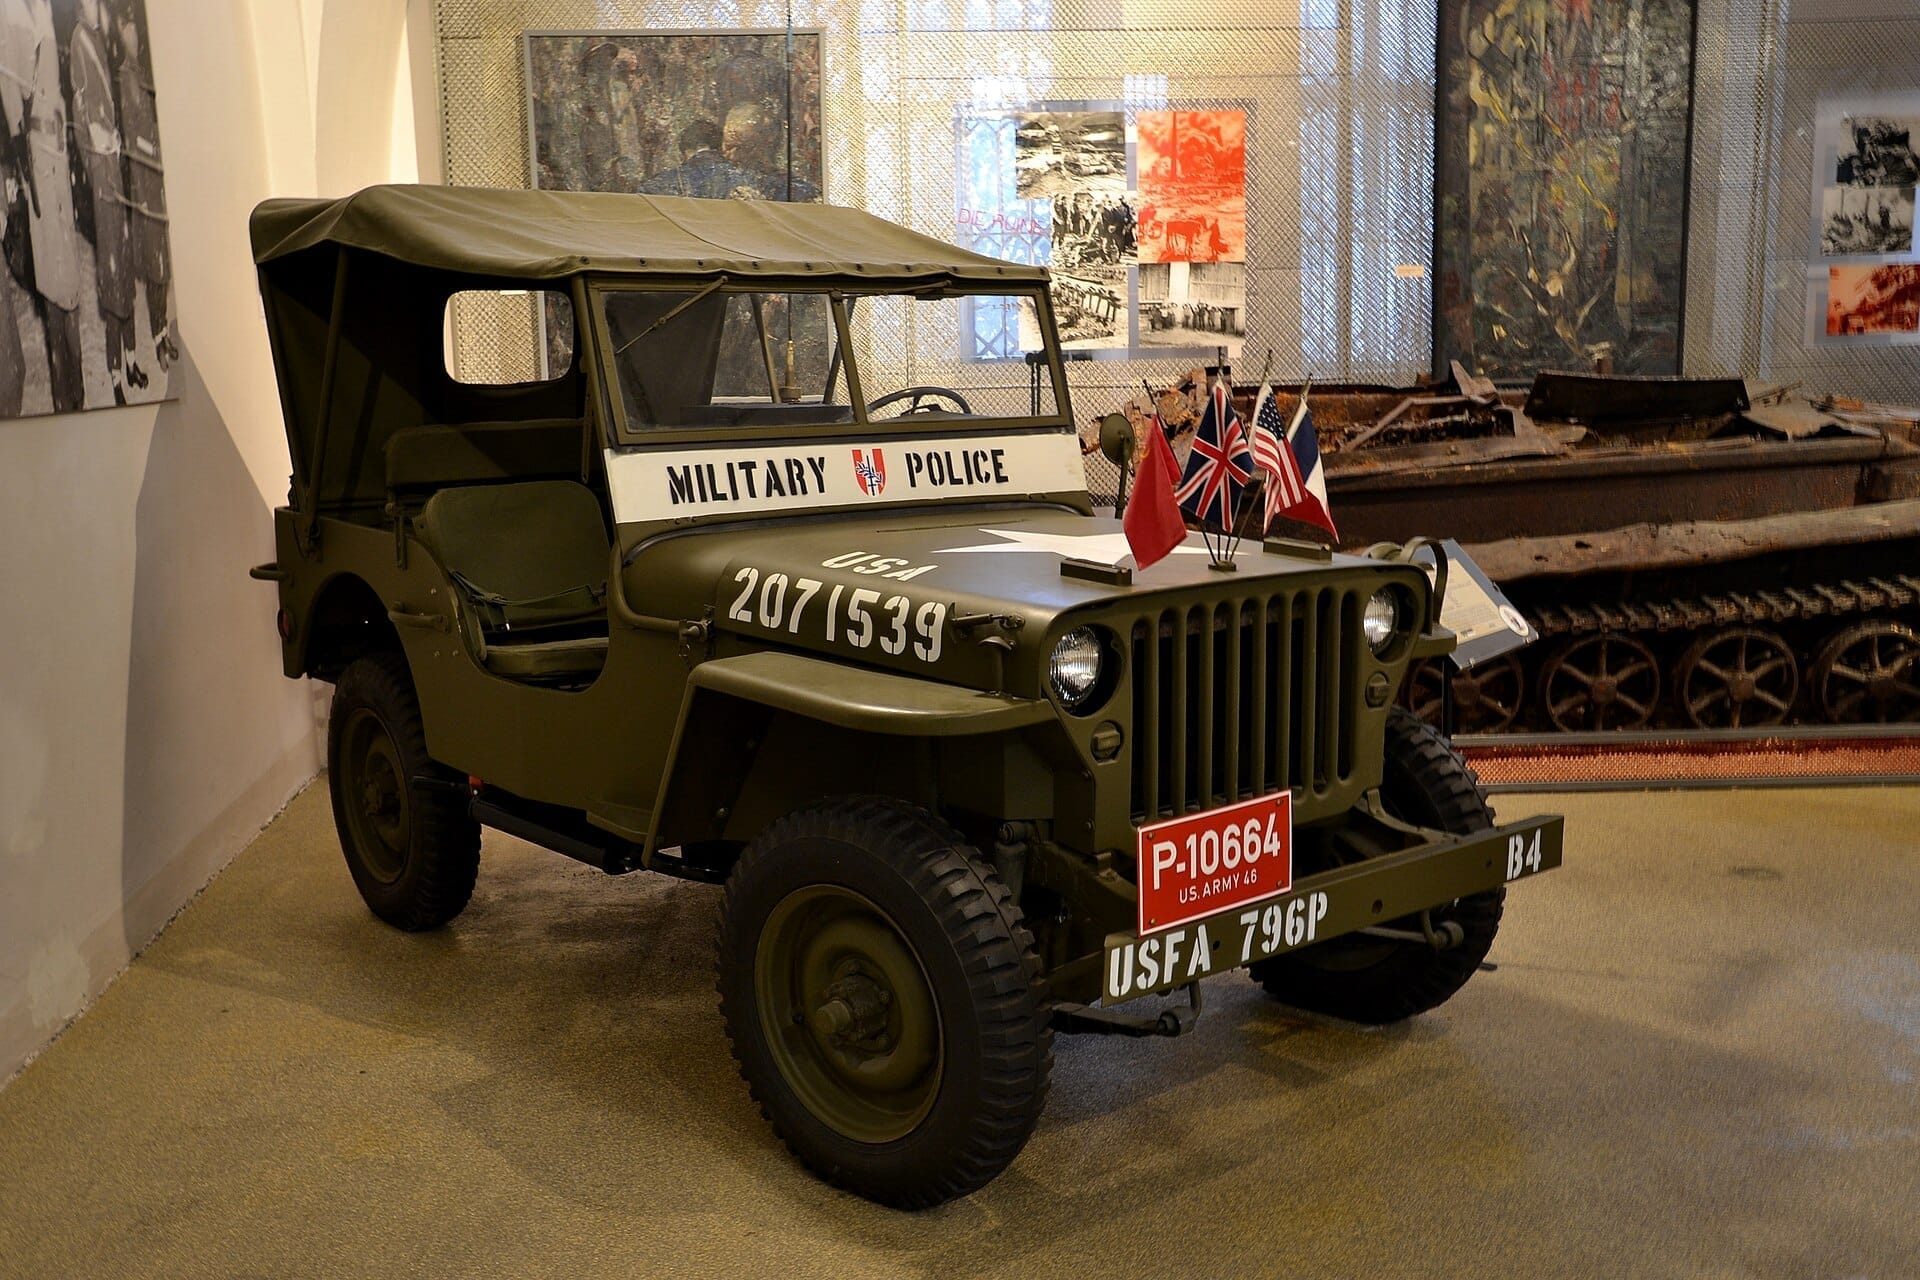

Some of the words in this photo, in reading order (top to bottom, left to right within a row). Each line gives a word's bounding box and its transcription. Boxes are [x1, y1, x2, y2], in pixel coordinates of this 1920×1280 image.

[957, 207, 986, 227] DIE
[666, 456, 825, 505] MILITARY
[904, 448, 1009, 488] POLICE
[821, 551, 939, 582] USA
[728, 567, 946, 663] 2071539
[1152, 812, 1281, 890] P-10664
[1506, 828, 1542, 881] B4
[1202, 871, 1240, 898] ARMY
[1243, 867, 1258, 885] 46
[1109, 924, 1211, 997] USFA
[1240, 891, 1328, 962] 796P
